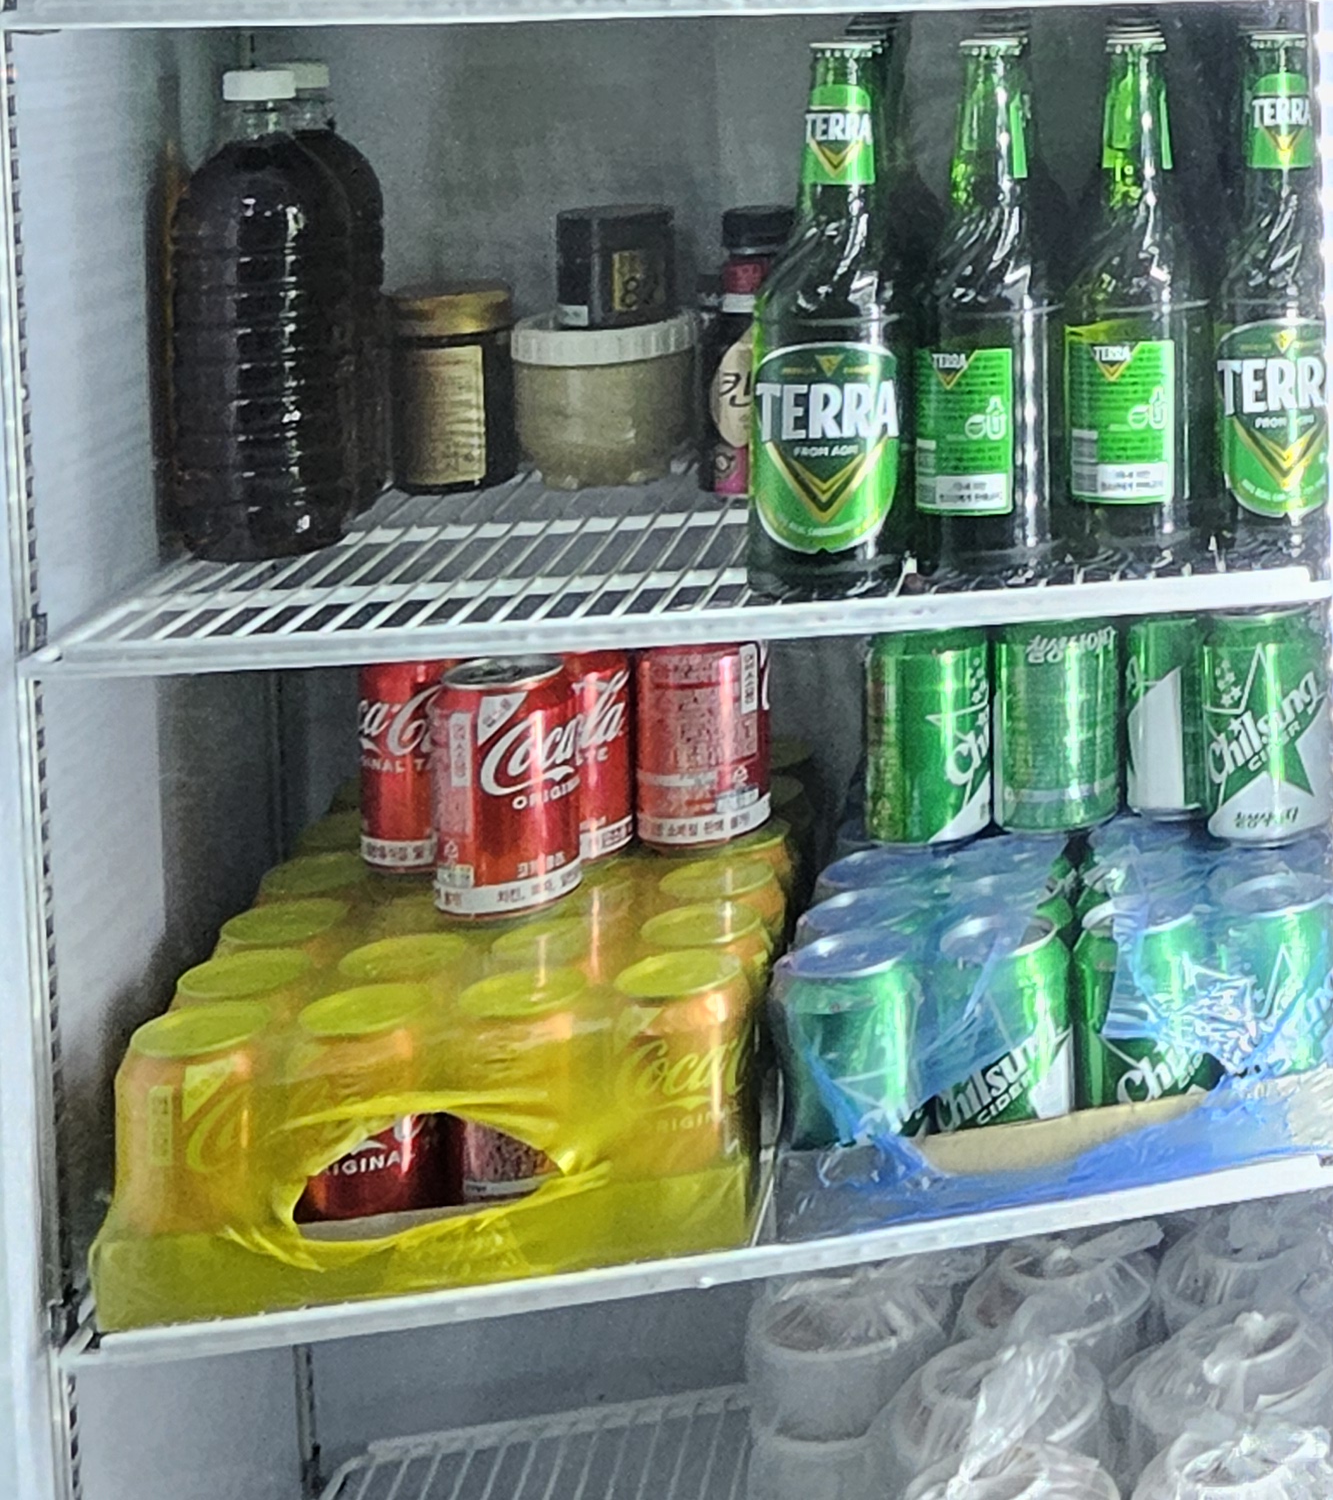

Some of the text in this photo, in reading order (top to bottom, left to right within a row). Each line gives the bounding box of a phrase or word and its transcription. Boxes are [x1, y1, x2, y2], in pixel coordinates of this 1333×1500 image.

[805, 112, 874, 146] TERRA
[1252, 97, 1313, 128] TERRA
[932, 352, 967, 369] TERRA
[1093, 345, 1132, 362] TERRA
[1217, 356, 1327, 416] TERR
[755, 379, 900, 442] TERRA
[1209, 671, 1327, 785] Chilsung
